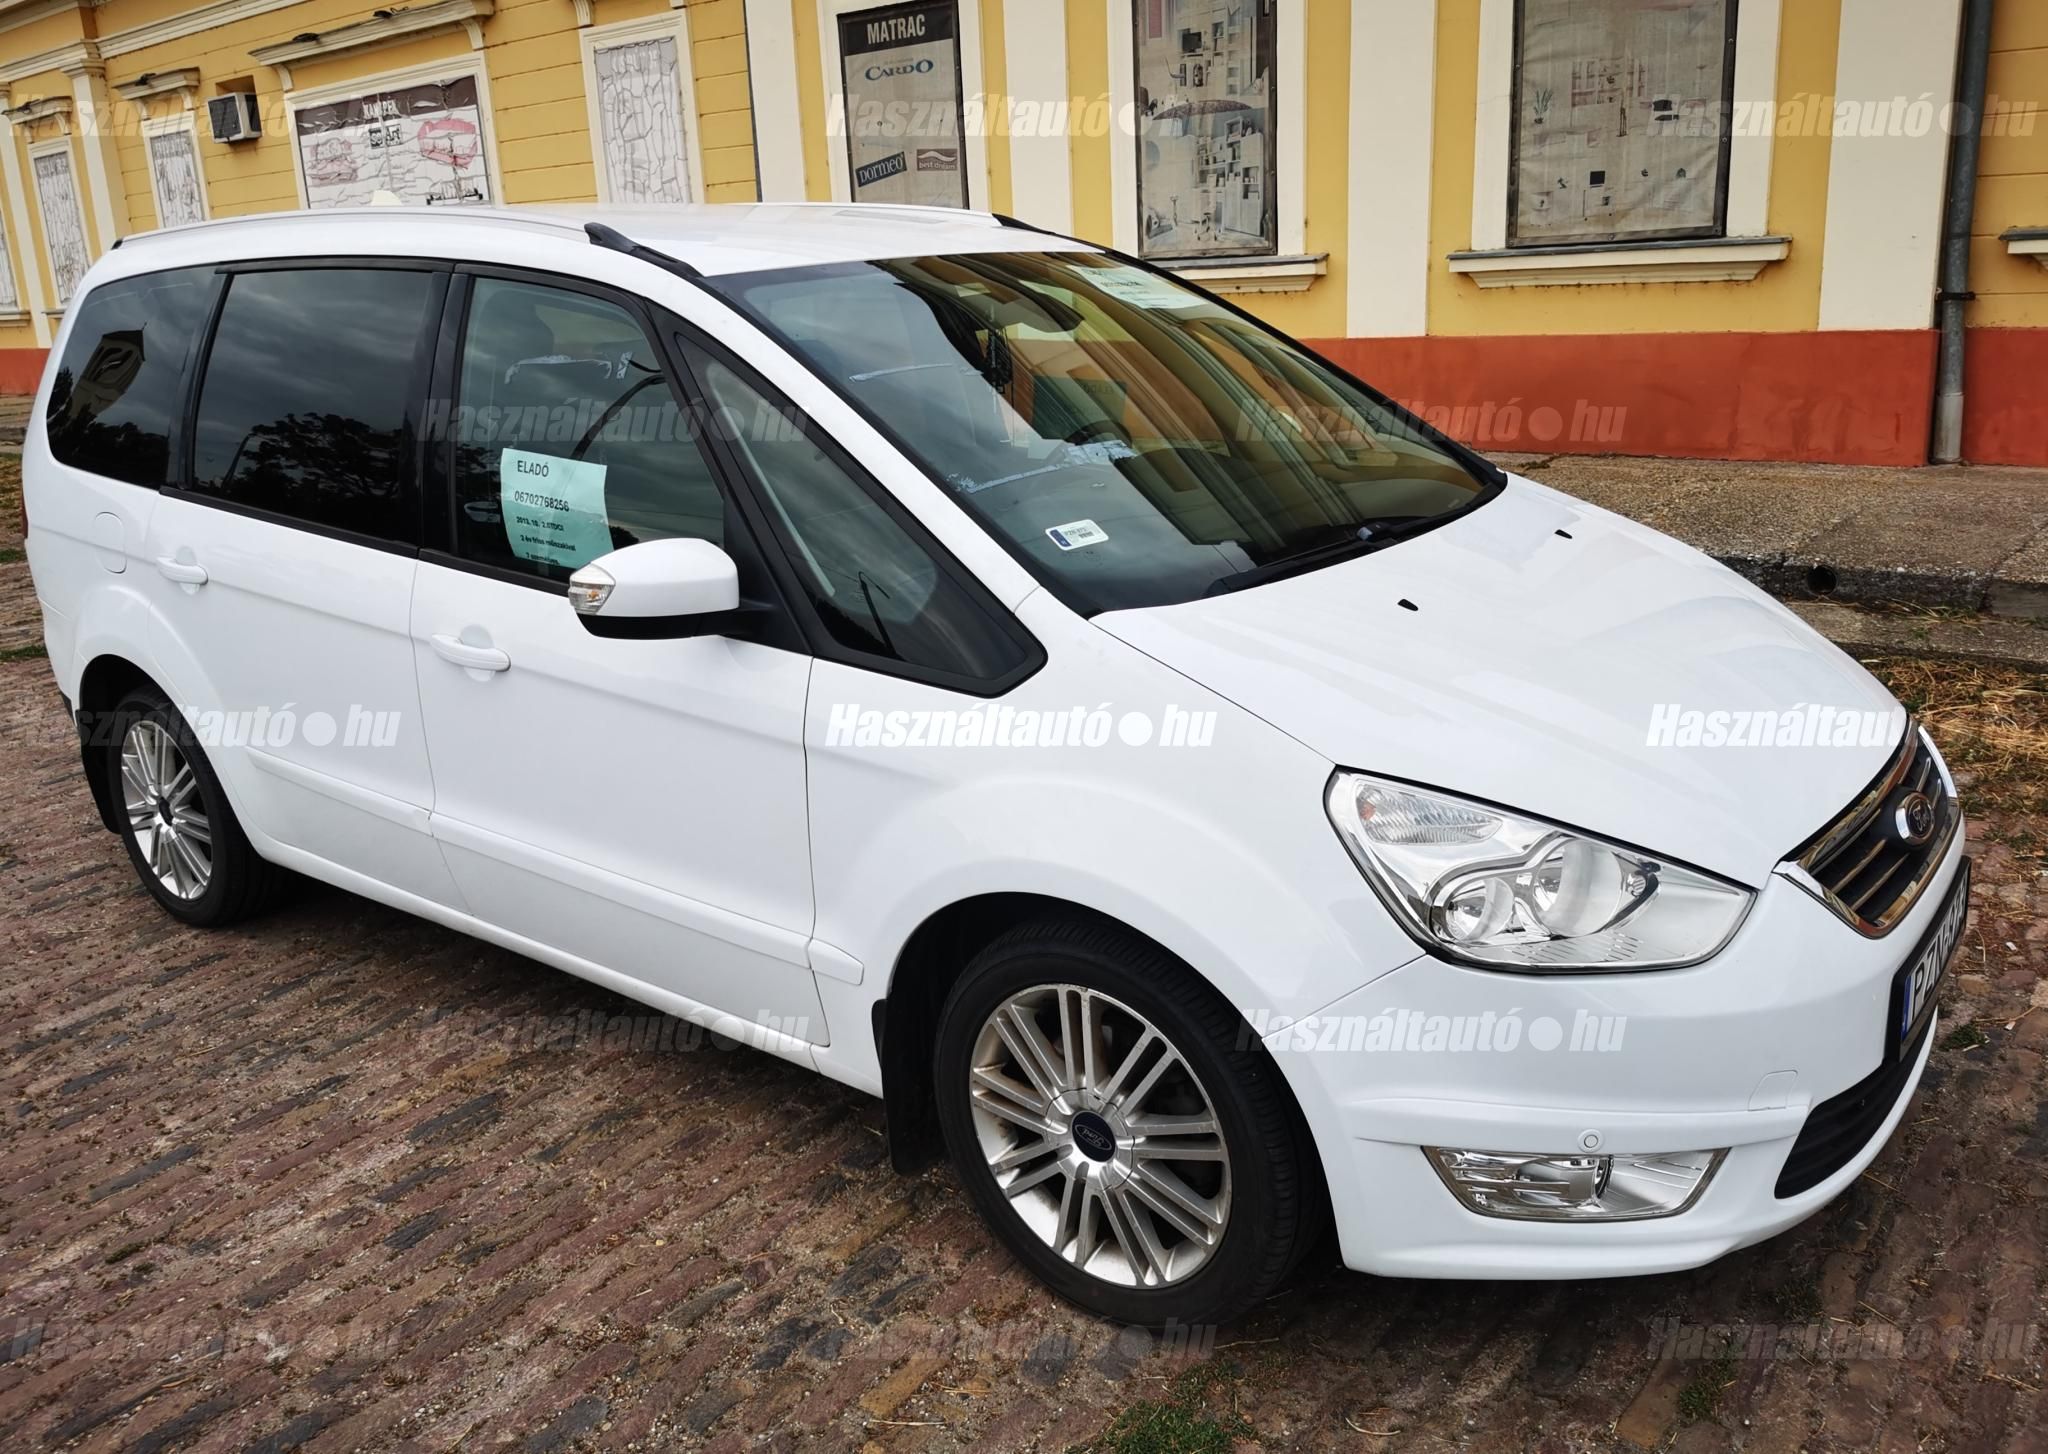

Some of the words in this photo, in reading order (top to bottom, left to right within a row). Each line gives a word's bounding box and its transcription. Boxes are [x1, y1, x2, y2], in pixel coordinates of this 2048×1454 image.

[867, 14, 925, 45] MATRAC
[517, 461, 549, 477] ELADÓ
[514, 491, 569, 512] 06702768256
